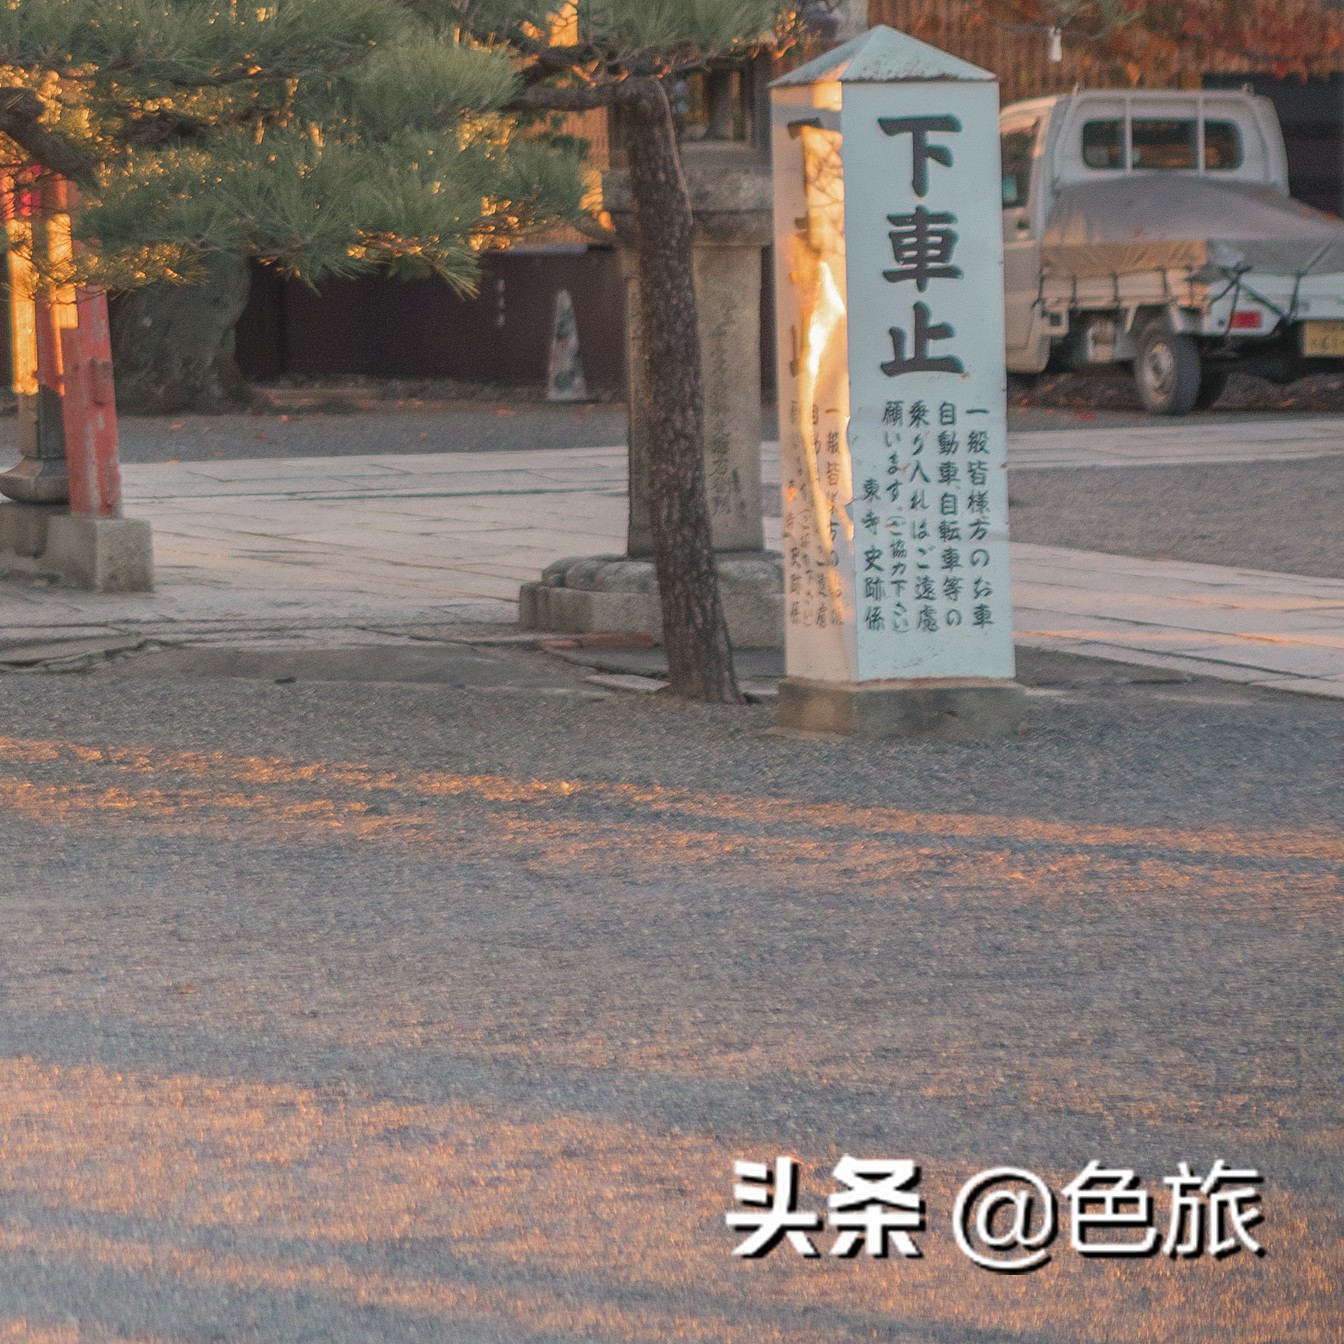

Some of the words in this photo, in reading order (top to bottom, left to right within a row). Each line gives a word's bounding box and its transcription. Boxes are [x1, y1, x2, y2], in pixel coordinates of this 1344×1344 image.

[877, 113, 964, 377] 下車止
[965, 407, 995, 629] 一般皆様方のお車
